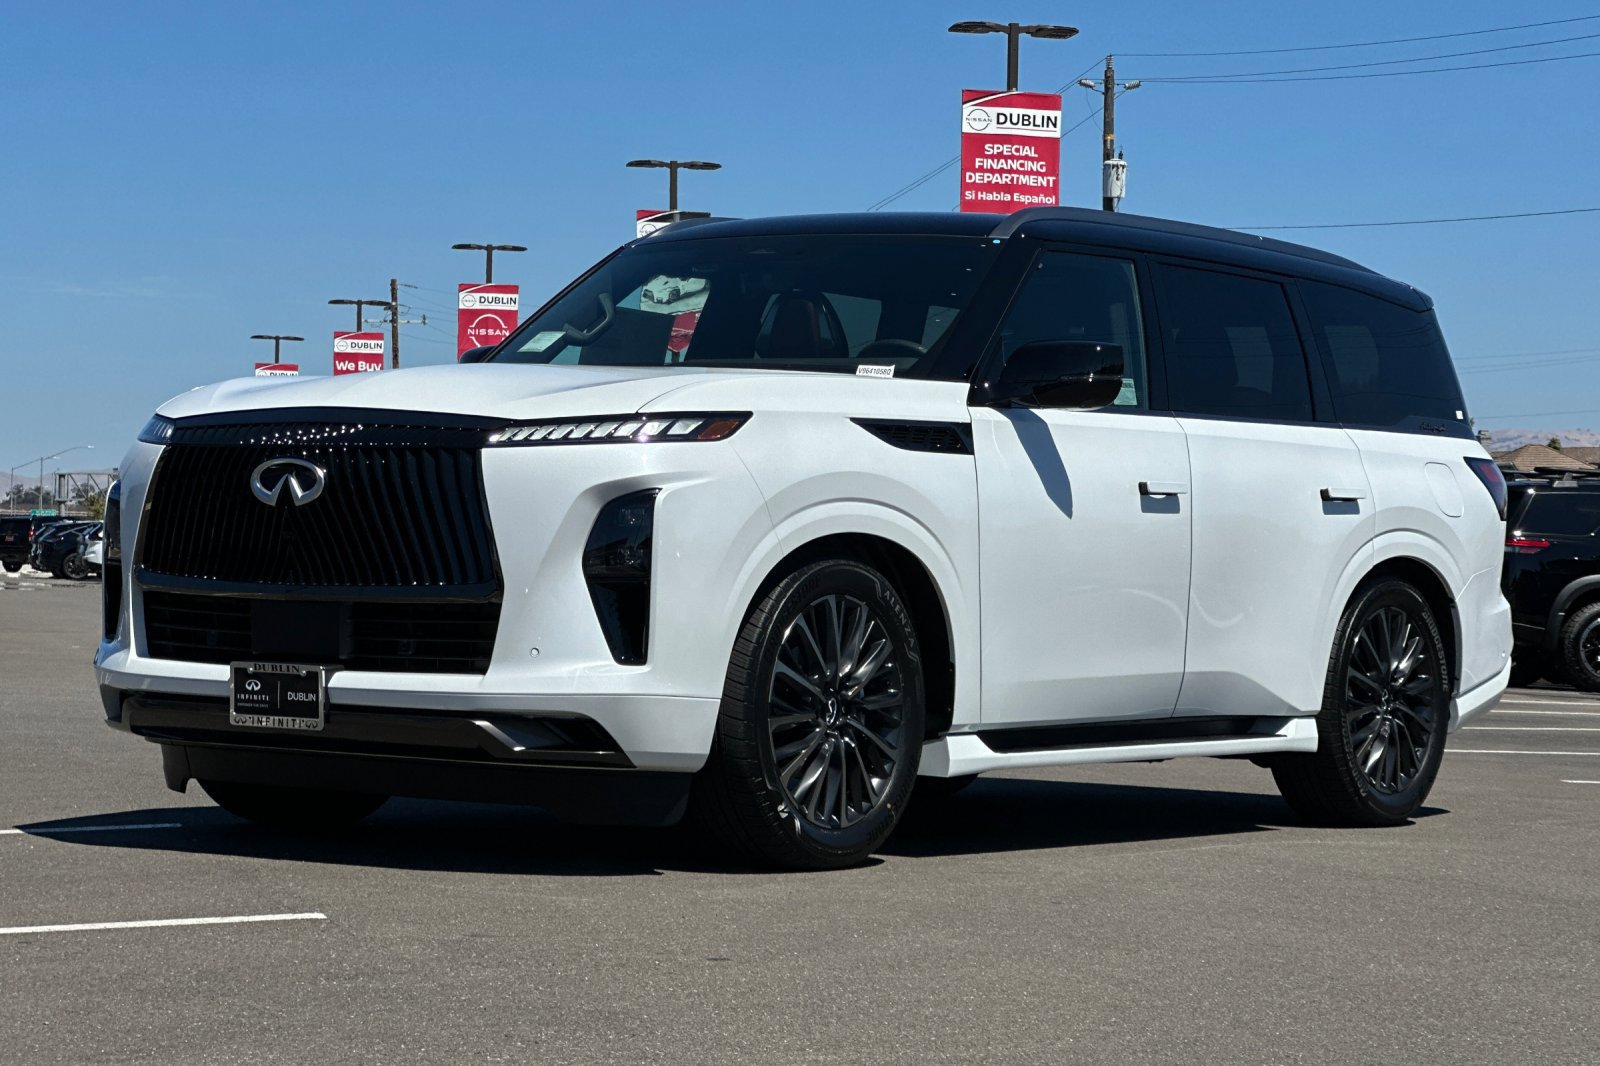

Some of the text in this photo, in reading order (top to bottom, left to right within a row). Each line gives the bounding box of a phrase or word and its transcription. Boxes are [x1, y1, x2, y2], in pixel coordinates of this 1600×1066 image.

[996, 112, 1058, 128] DUBLIN
[984, 144, 1038, 157] SPECIAL
[975, 158, 1046, 172] FINANCING
[966, 172, 1056, 187] DEPARTMENT
[964, 191, 1056, 205] Si Habla Español
[479, 296, 516, 305] DUBLIN
[336, 360, 355, 370] We
[883, 590, 915, 648] ALENZA
[253, 663, 300, 672] DUBLIN
[287, 692, 316, 702] DUBLIN
[251, 716, 302, 728] INFINITI
